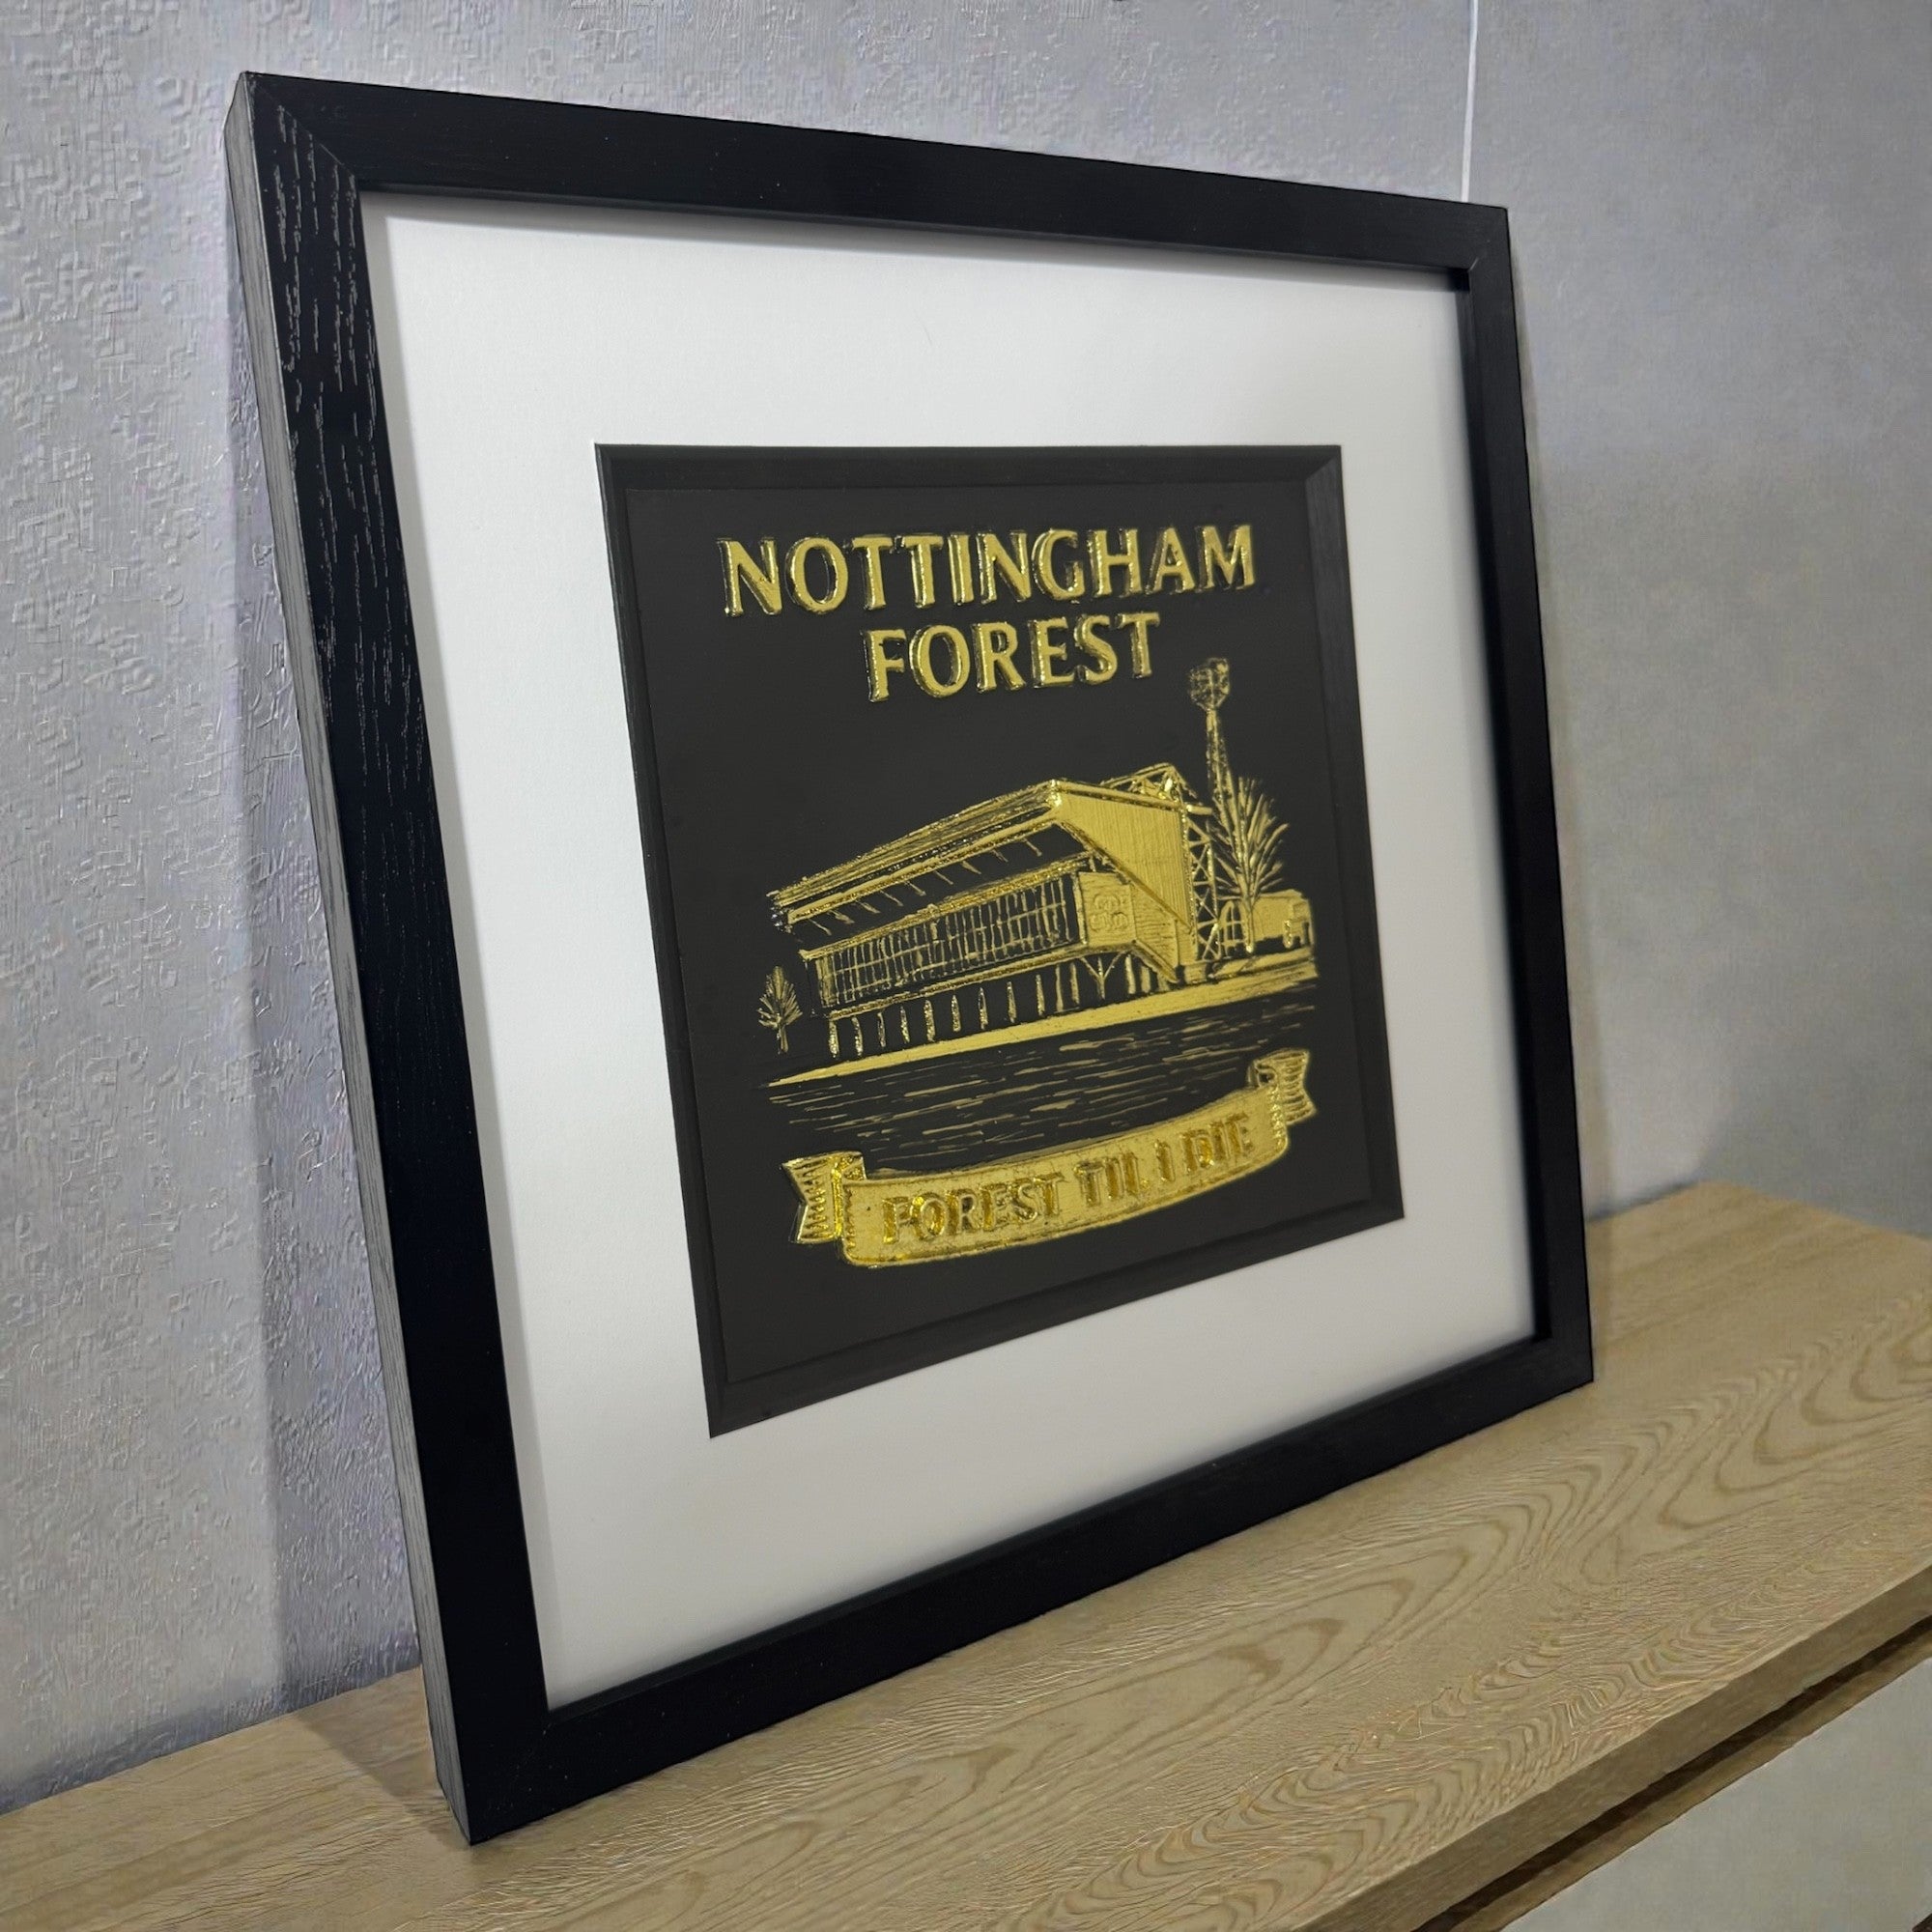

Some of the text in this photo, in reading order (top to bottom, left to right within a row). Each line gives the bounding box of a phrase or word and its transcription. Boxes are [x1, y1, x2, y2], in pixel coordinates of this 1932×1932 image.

[717, 525, 1255, 615] NOTTINGHAM
[862, 611, 1160, 702] FOREST
[881, 1171, 1065, 1245] FOREST
[1153, 1138, 1176, 1183] I
[1179, 1111, 1254, 1175] DIE
